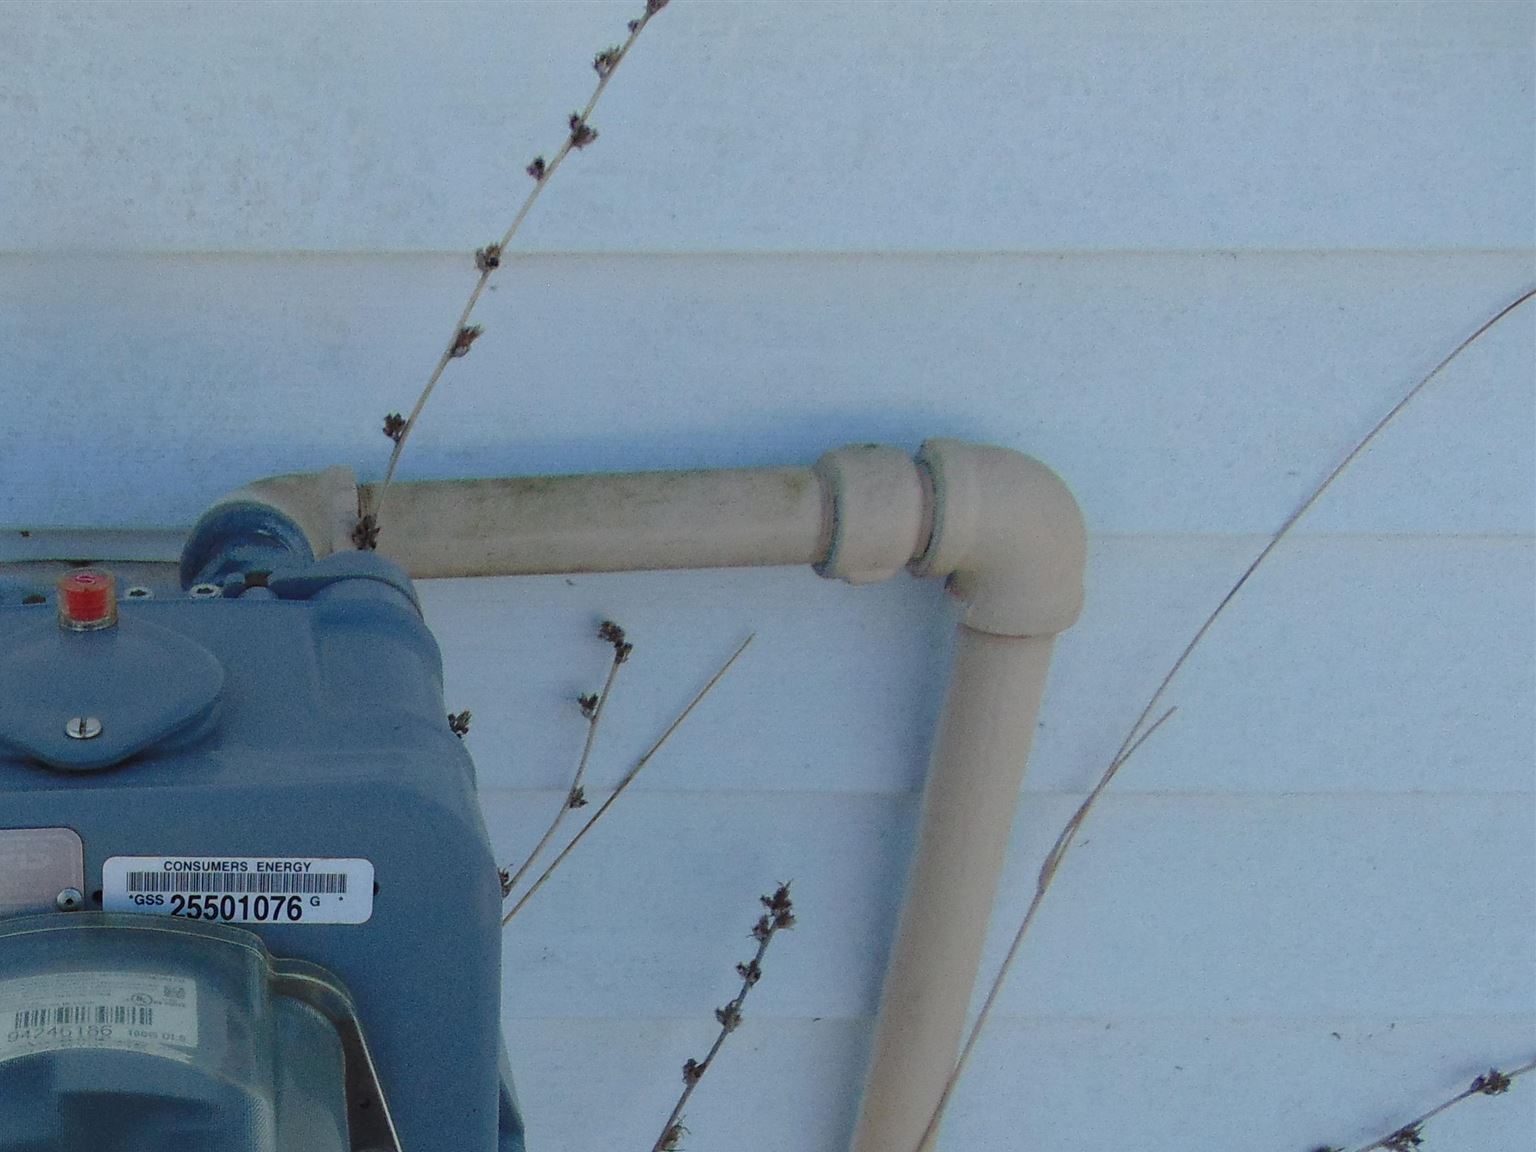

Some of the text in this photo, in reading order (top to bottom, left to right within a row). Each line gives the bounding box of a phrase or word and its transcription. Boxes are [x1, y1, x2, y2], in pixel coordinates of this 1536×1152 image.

[164, 861, 312, 873] CONSUMERS ENERGY
[170, 894, 303, 922] 25501076
[309, 896, 321, 907] G
